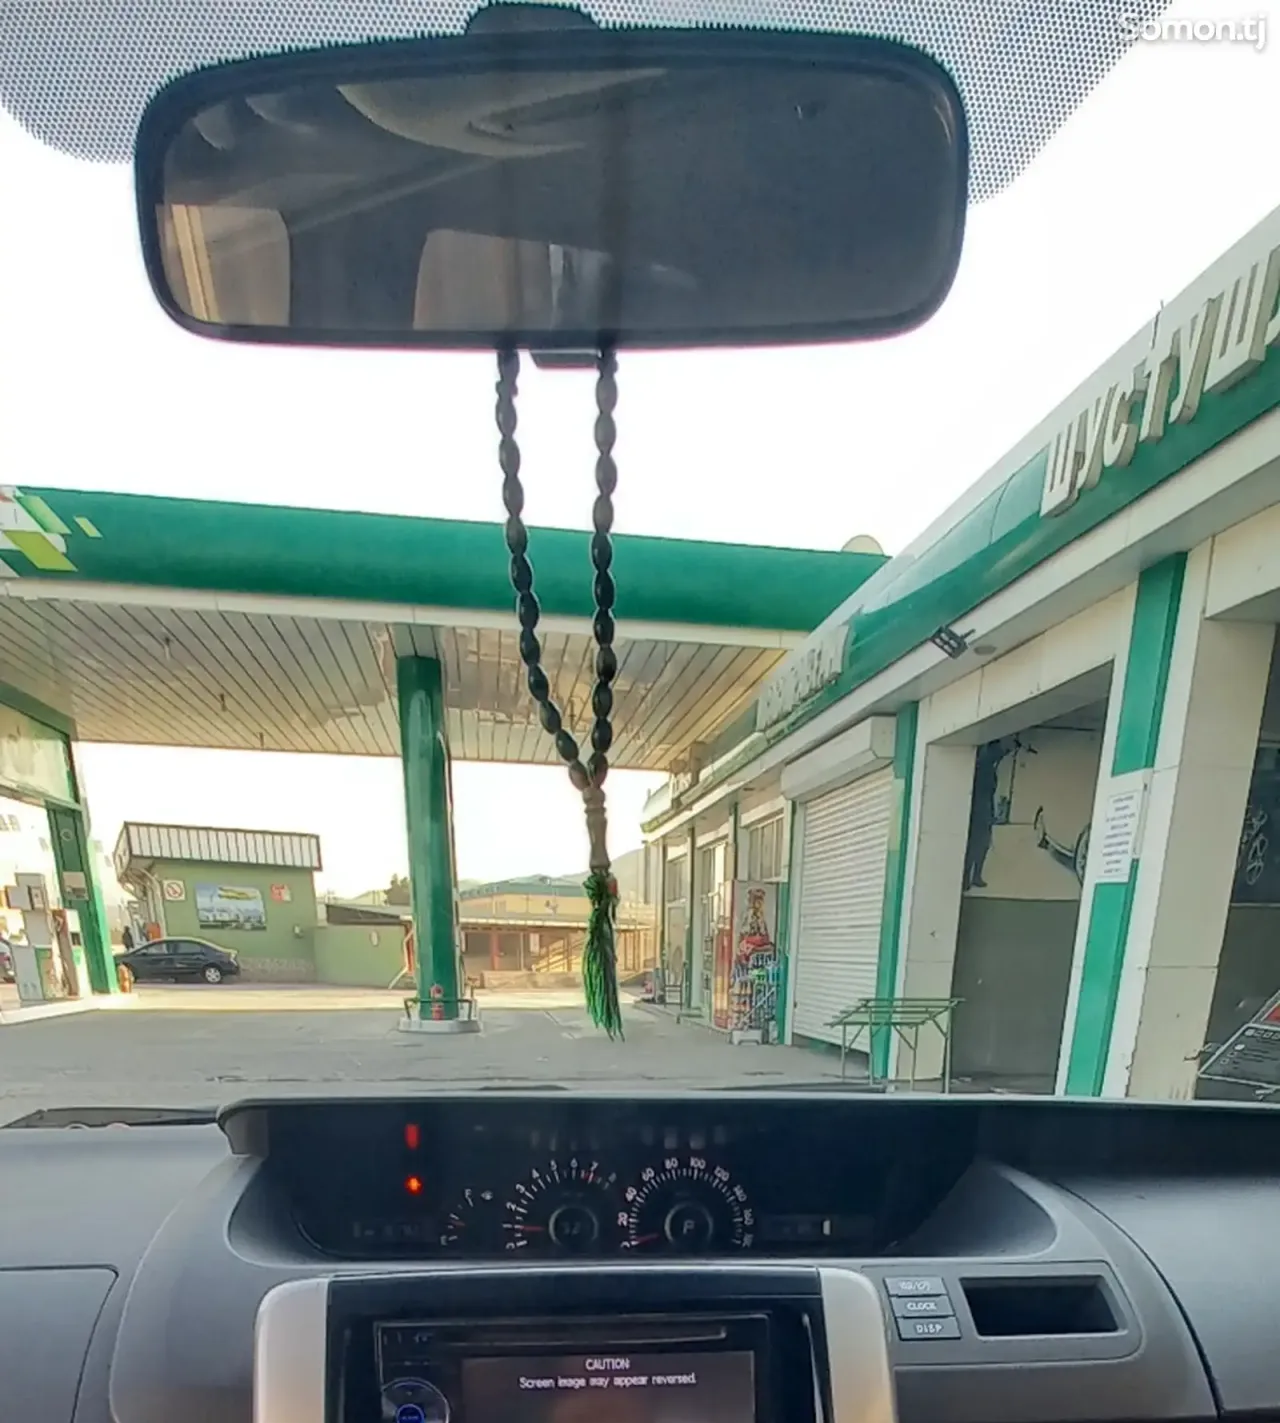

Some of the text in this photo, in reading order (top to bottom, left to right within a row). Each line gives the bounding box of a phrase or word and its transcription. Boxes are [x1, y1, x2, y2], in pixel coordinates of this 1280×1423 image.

[1040, 244, 1280, 518] ШУСТУШ
[664, 1158, 679, 1170] 80
[690, 1157, 706, 1170] 100
[641, 1167, 655, 1182] 60
[585, 1357, 630, 1371] CAUTION
[519, 1376, 555, 1389] Screen
